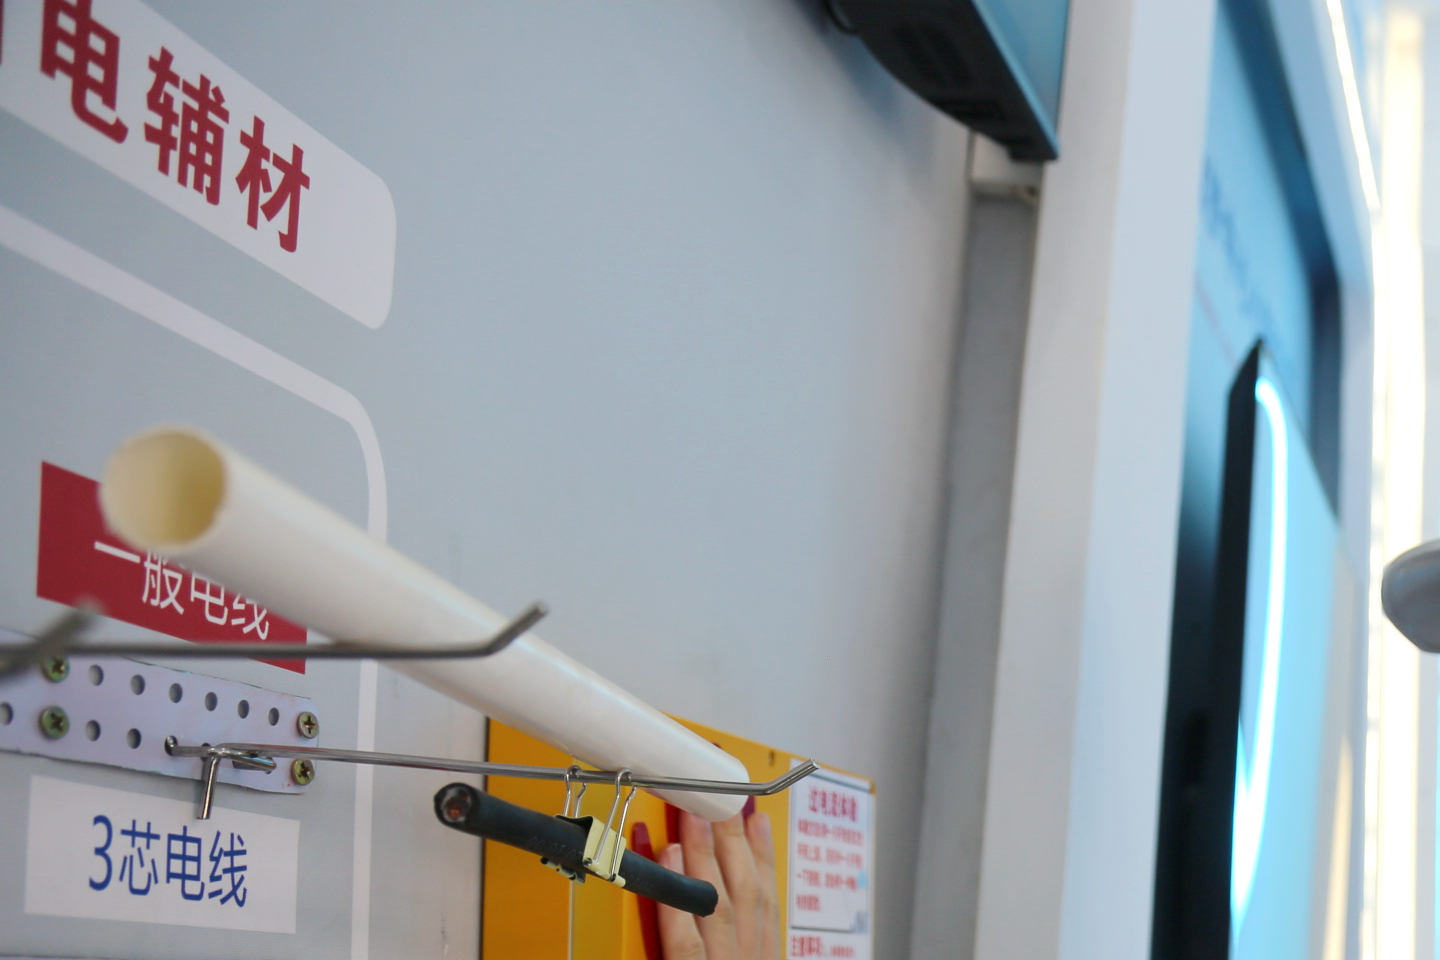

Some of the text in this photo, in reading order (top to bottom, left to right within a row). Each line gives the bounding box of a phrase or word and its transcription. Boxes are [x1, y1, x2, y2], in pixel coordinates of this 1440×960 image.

[0, 0, 310, 253] 电辅材
[94, 540, 269, 640] 一般电线
[89, 815, 248, 908] 3芯电线
